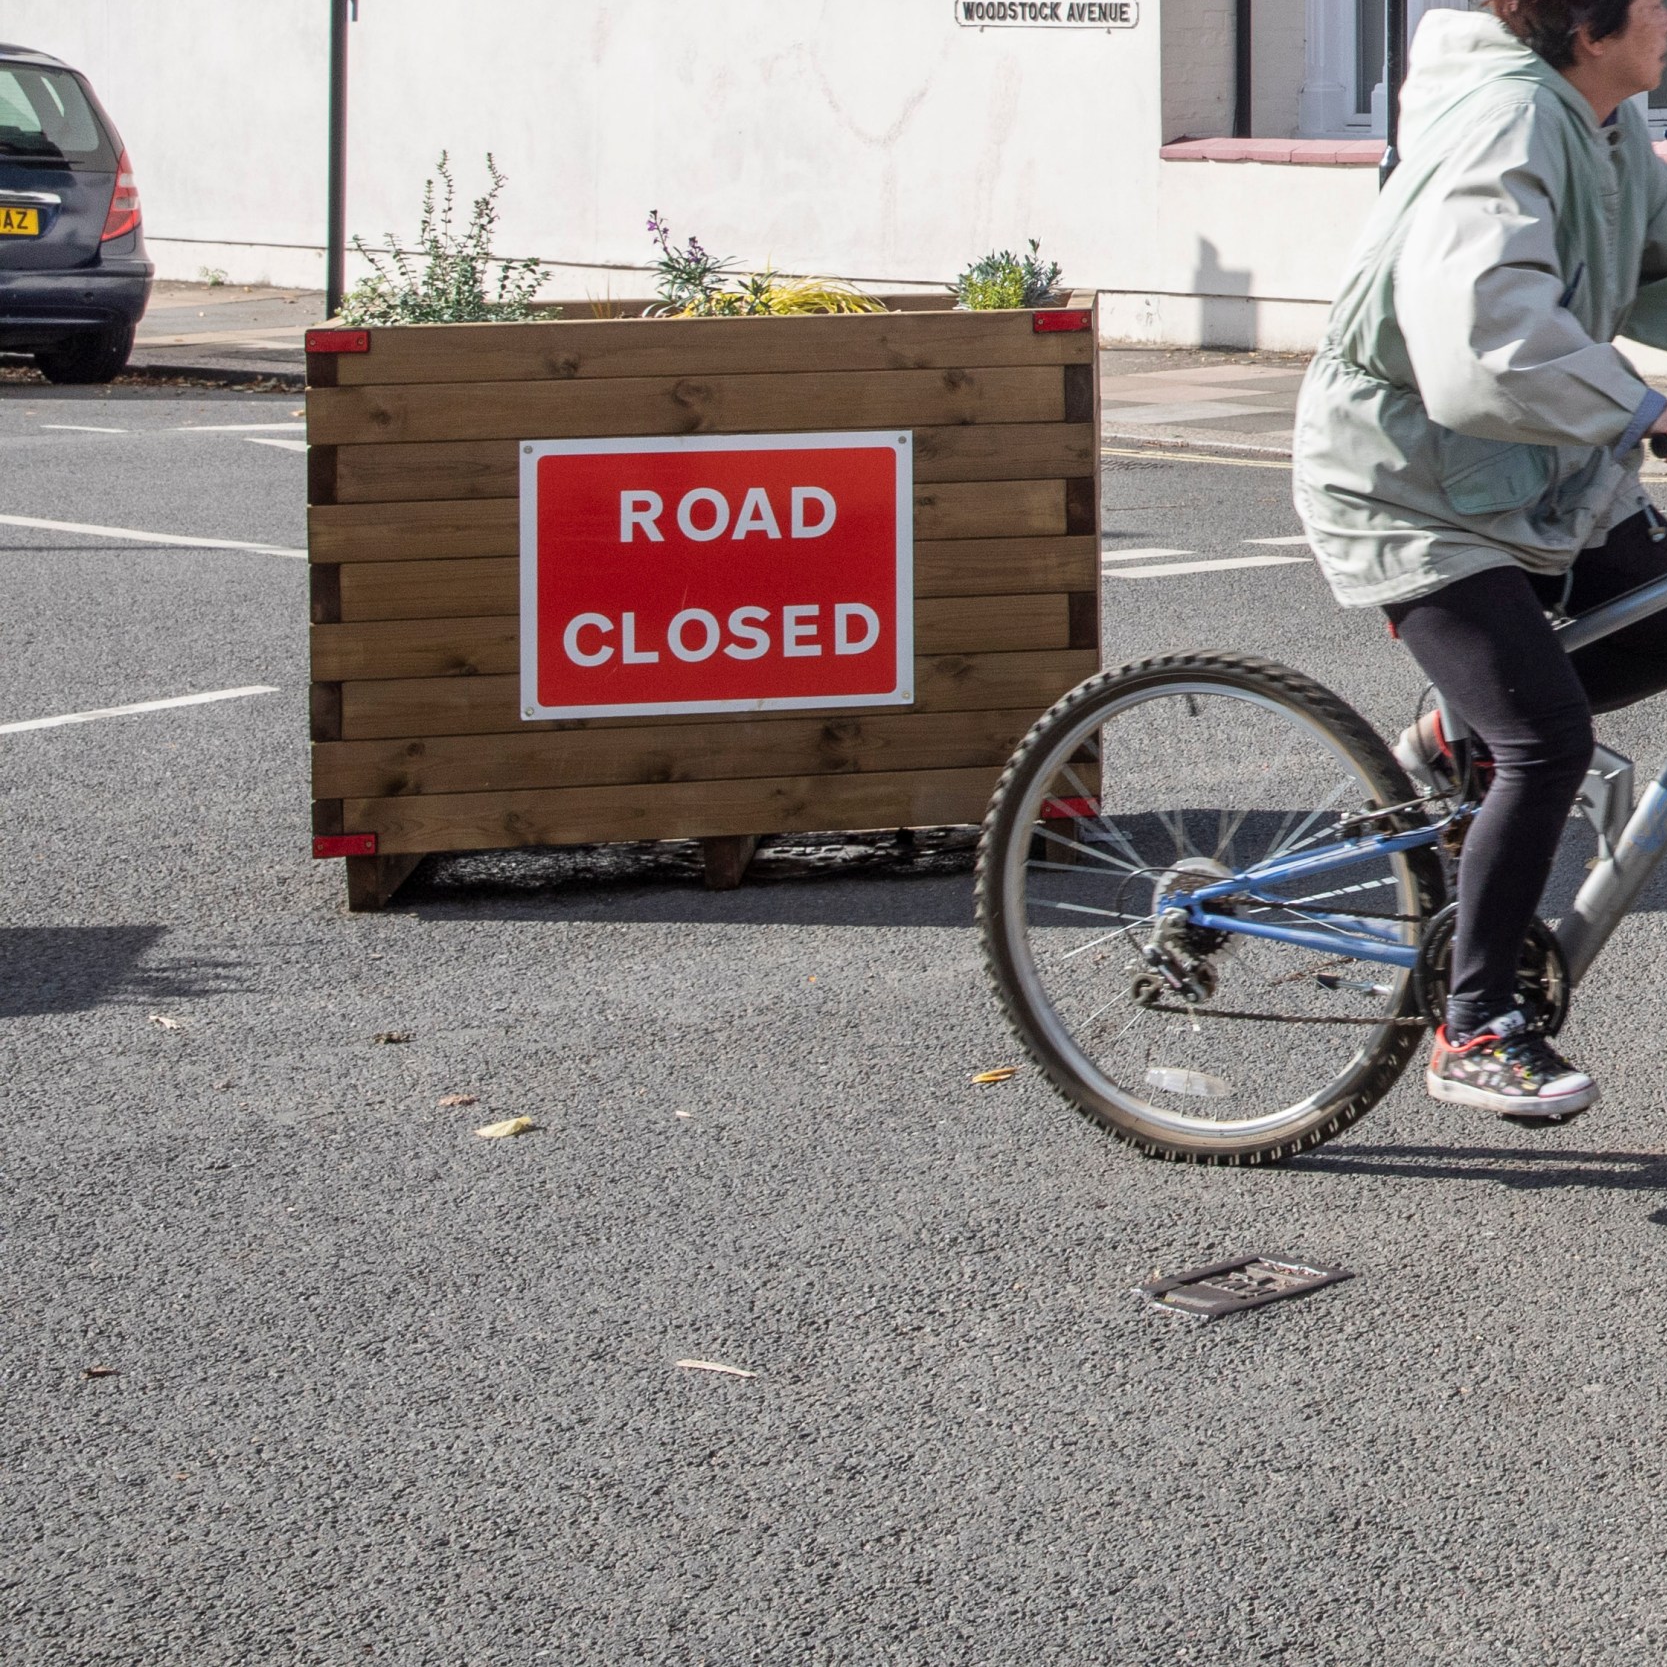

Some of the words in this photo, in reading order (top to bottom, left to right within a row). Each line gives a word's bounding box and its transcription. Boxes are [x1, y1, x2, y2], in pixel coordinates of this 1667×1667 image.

[962, 1, 1062, 22] WOODSTOCK
[1066, 2, 1131, 22] AVENUE
[0, 209, 29, 230] AZ
[620, 486, 837, 543] ROAD
[563, 602, 881, 667] CLOSED
